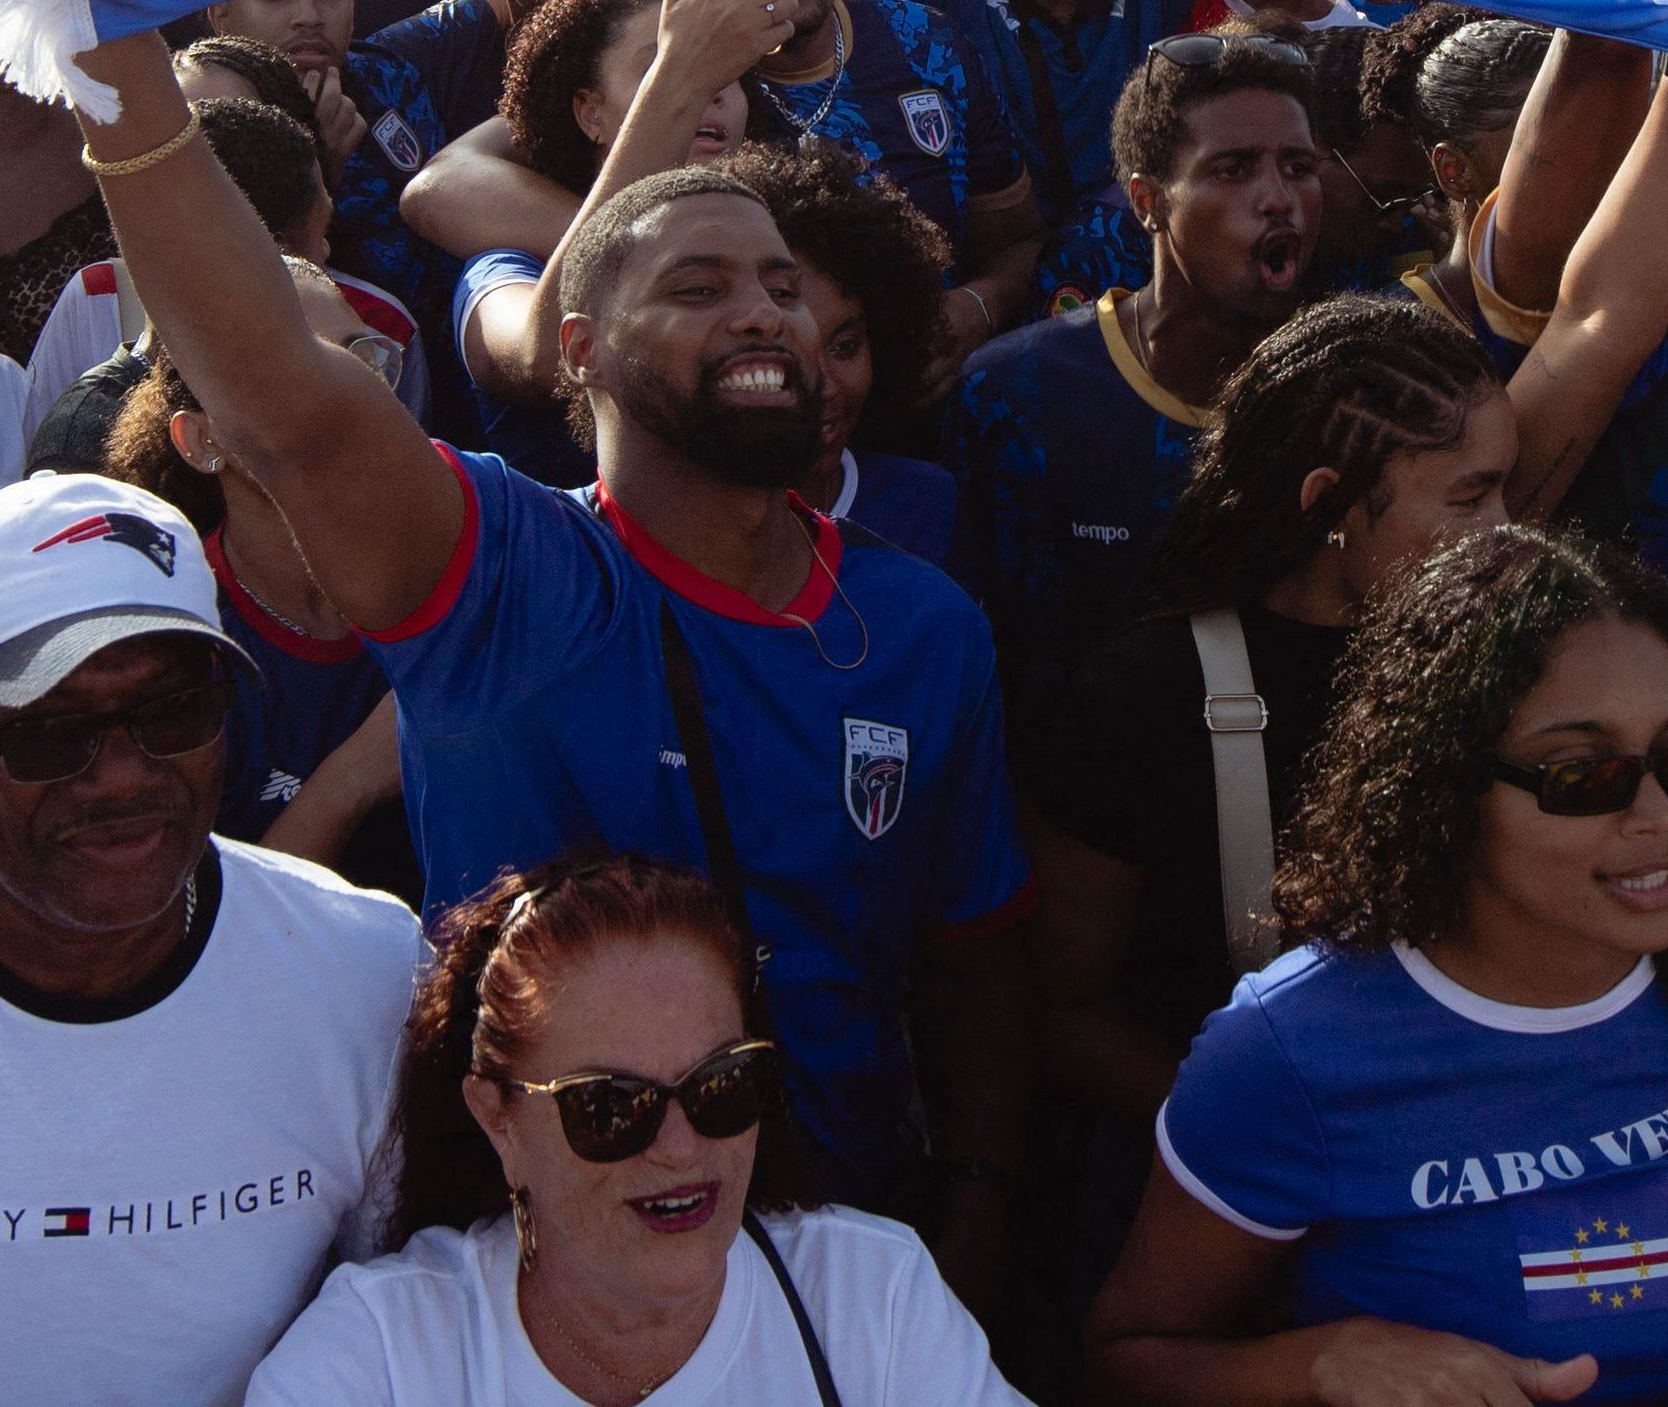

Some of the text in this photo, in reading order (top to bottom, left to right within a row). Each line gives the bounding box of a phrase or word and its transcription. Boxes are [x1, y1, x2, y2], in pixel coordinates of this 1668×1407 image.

[906, 96, 937, 109] FCF
[378, 117, 395, 139] FCF
[1071, 520, 1130, 545] tempo
[849, 725, 903, 745] FCF
[1411, 1142, 1585, 1211] CABO
[108, 1168, 315, 1235] HILFIGER
